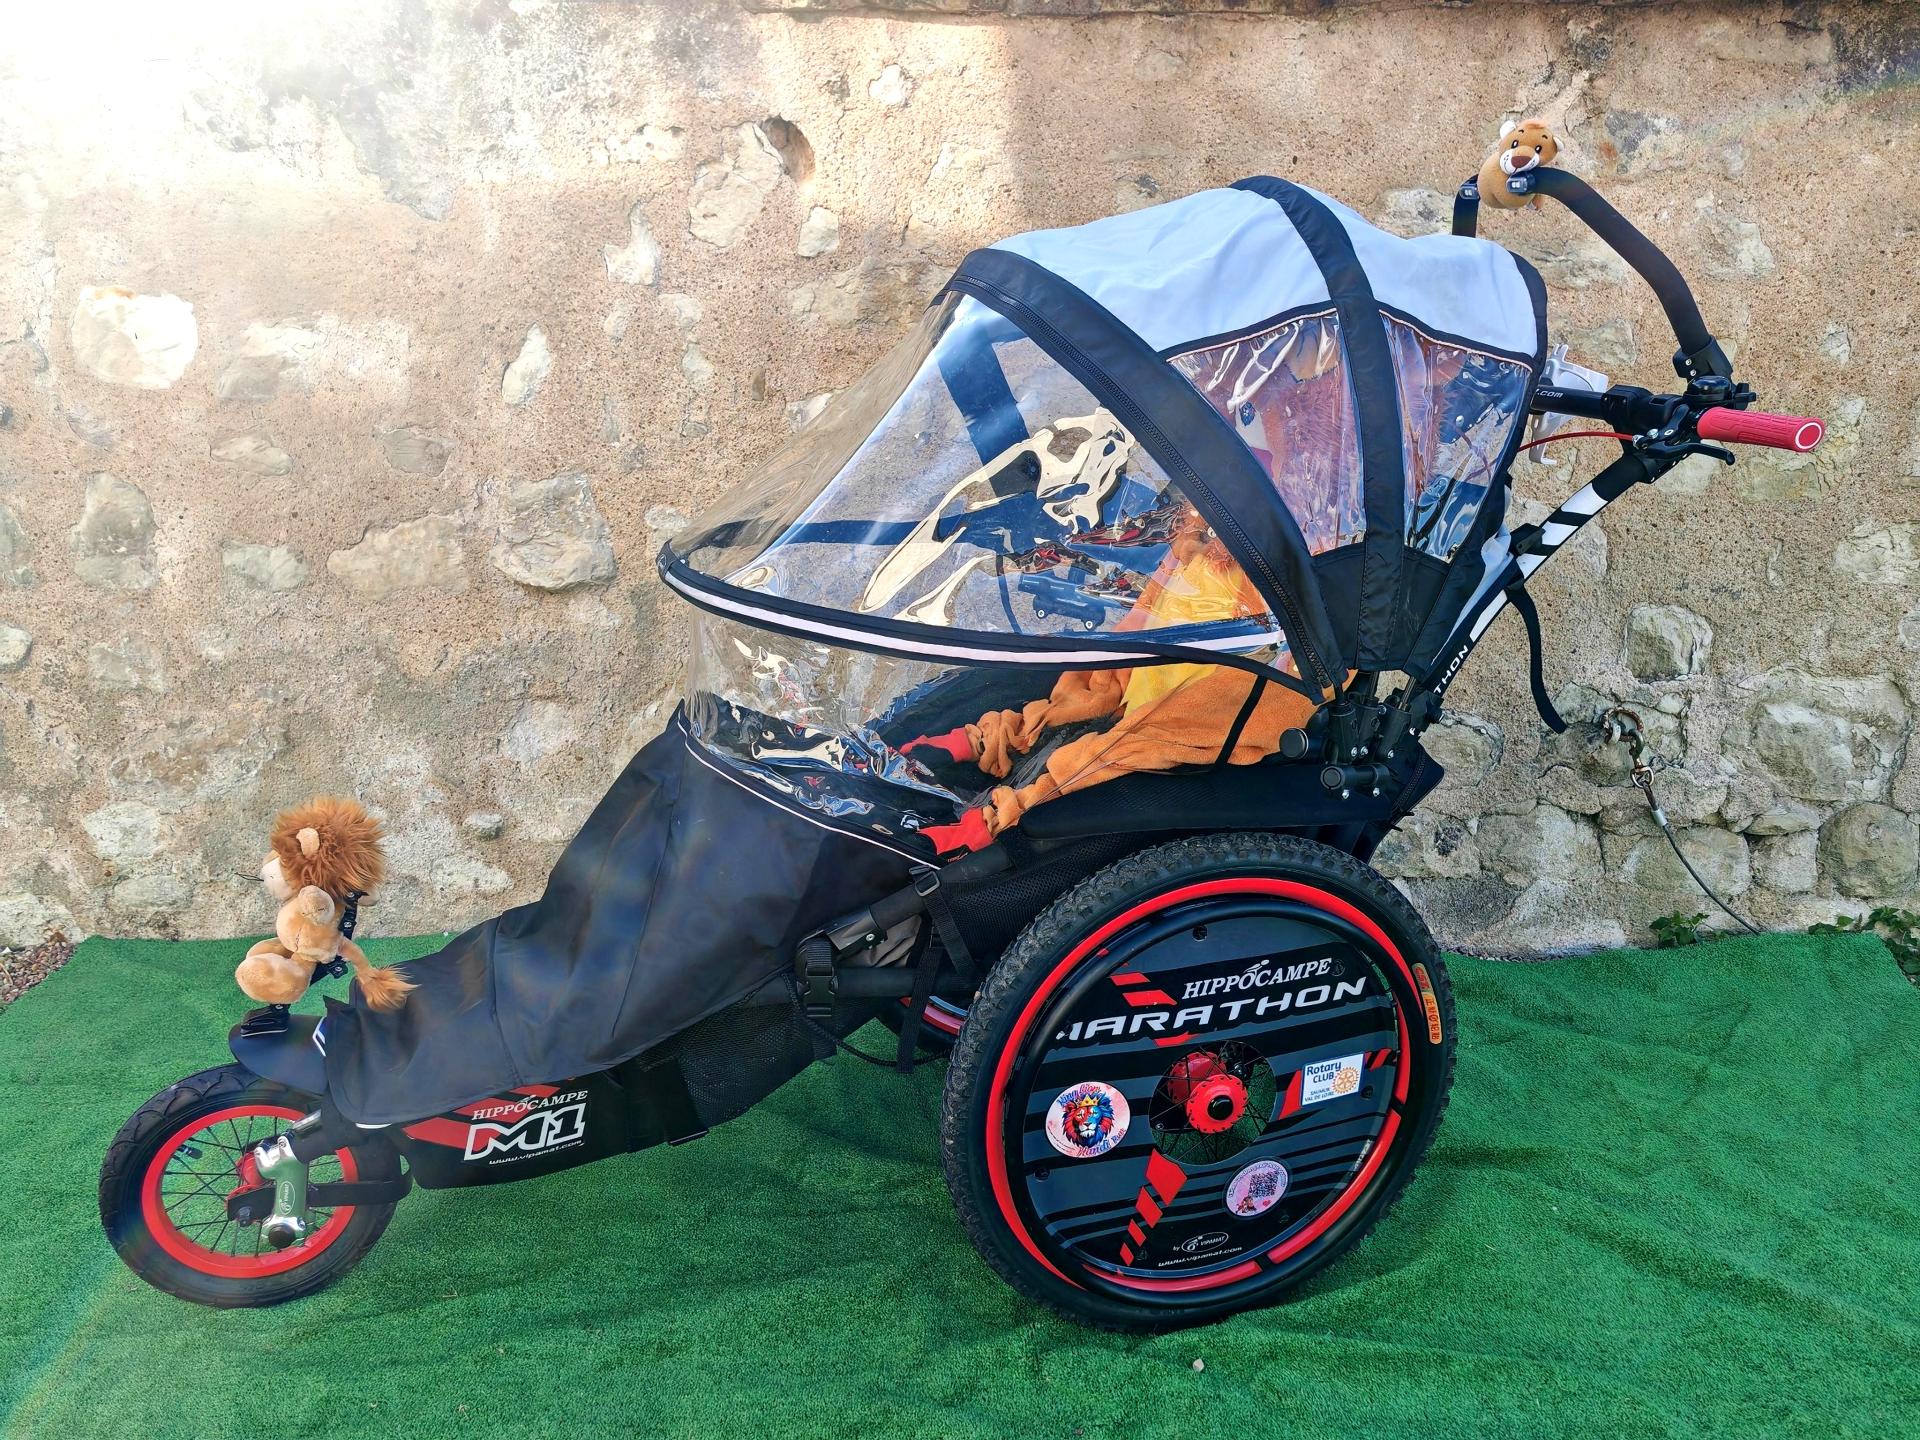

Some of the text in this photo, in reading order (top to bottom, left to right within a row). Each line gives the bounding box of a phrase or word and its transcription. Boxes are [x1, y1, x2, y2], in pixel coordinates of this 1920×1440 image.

[1535, 388, 1563, 398] .com
[1433, 645, 1468, 693] THON
[1181, 957, 1332, 1000] HIPPOCAMPE
[1306, 1062, 1341, 1083] Rotary CLUB
[471, 1090, 588, 1120] HIPPOCAMPE
